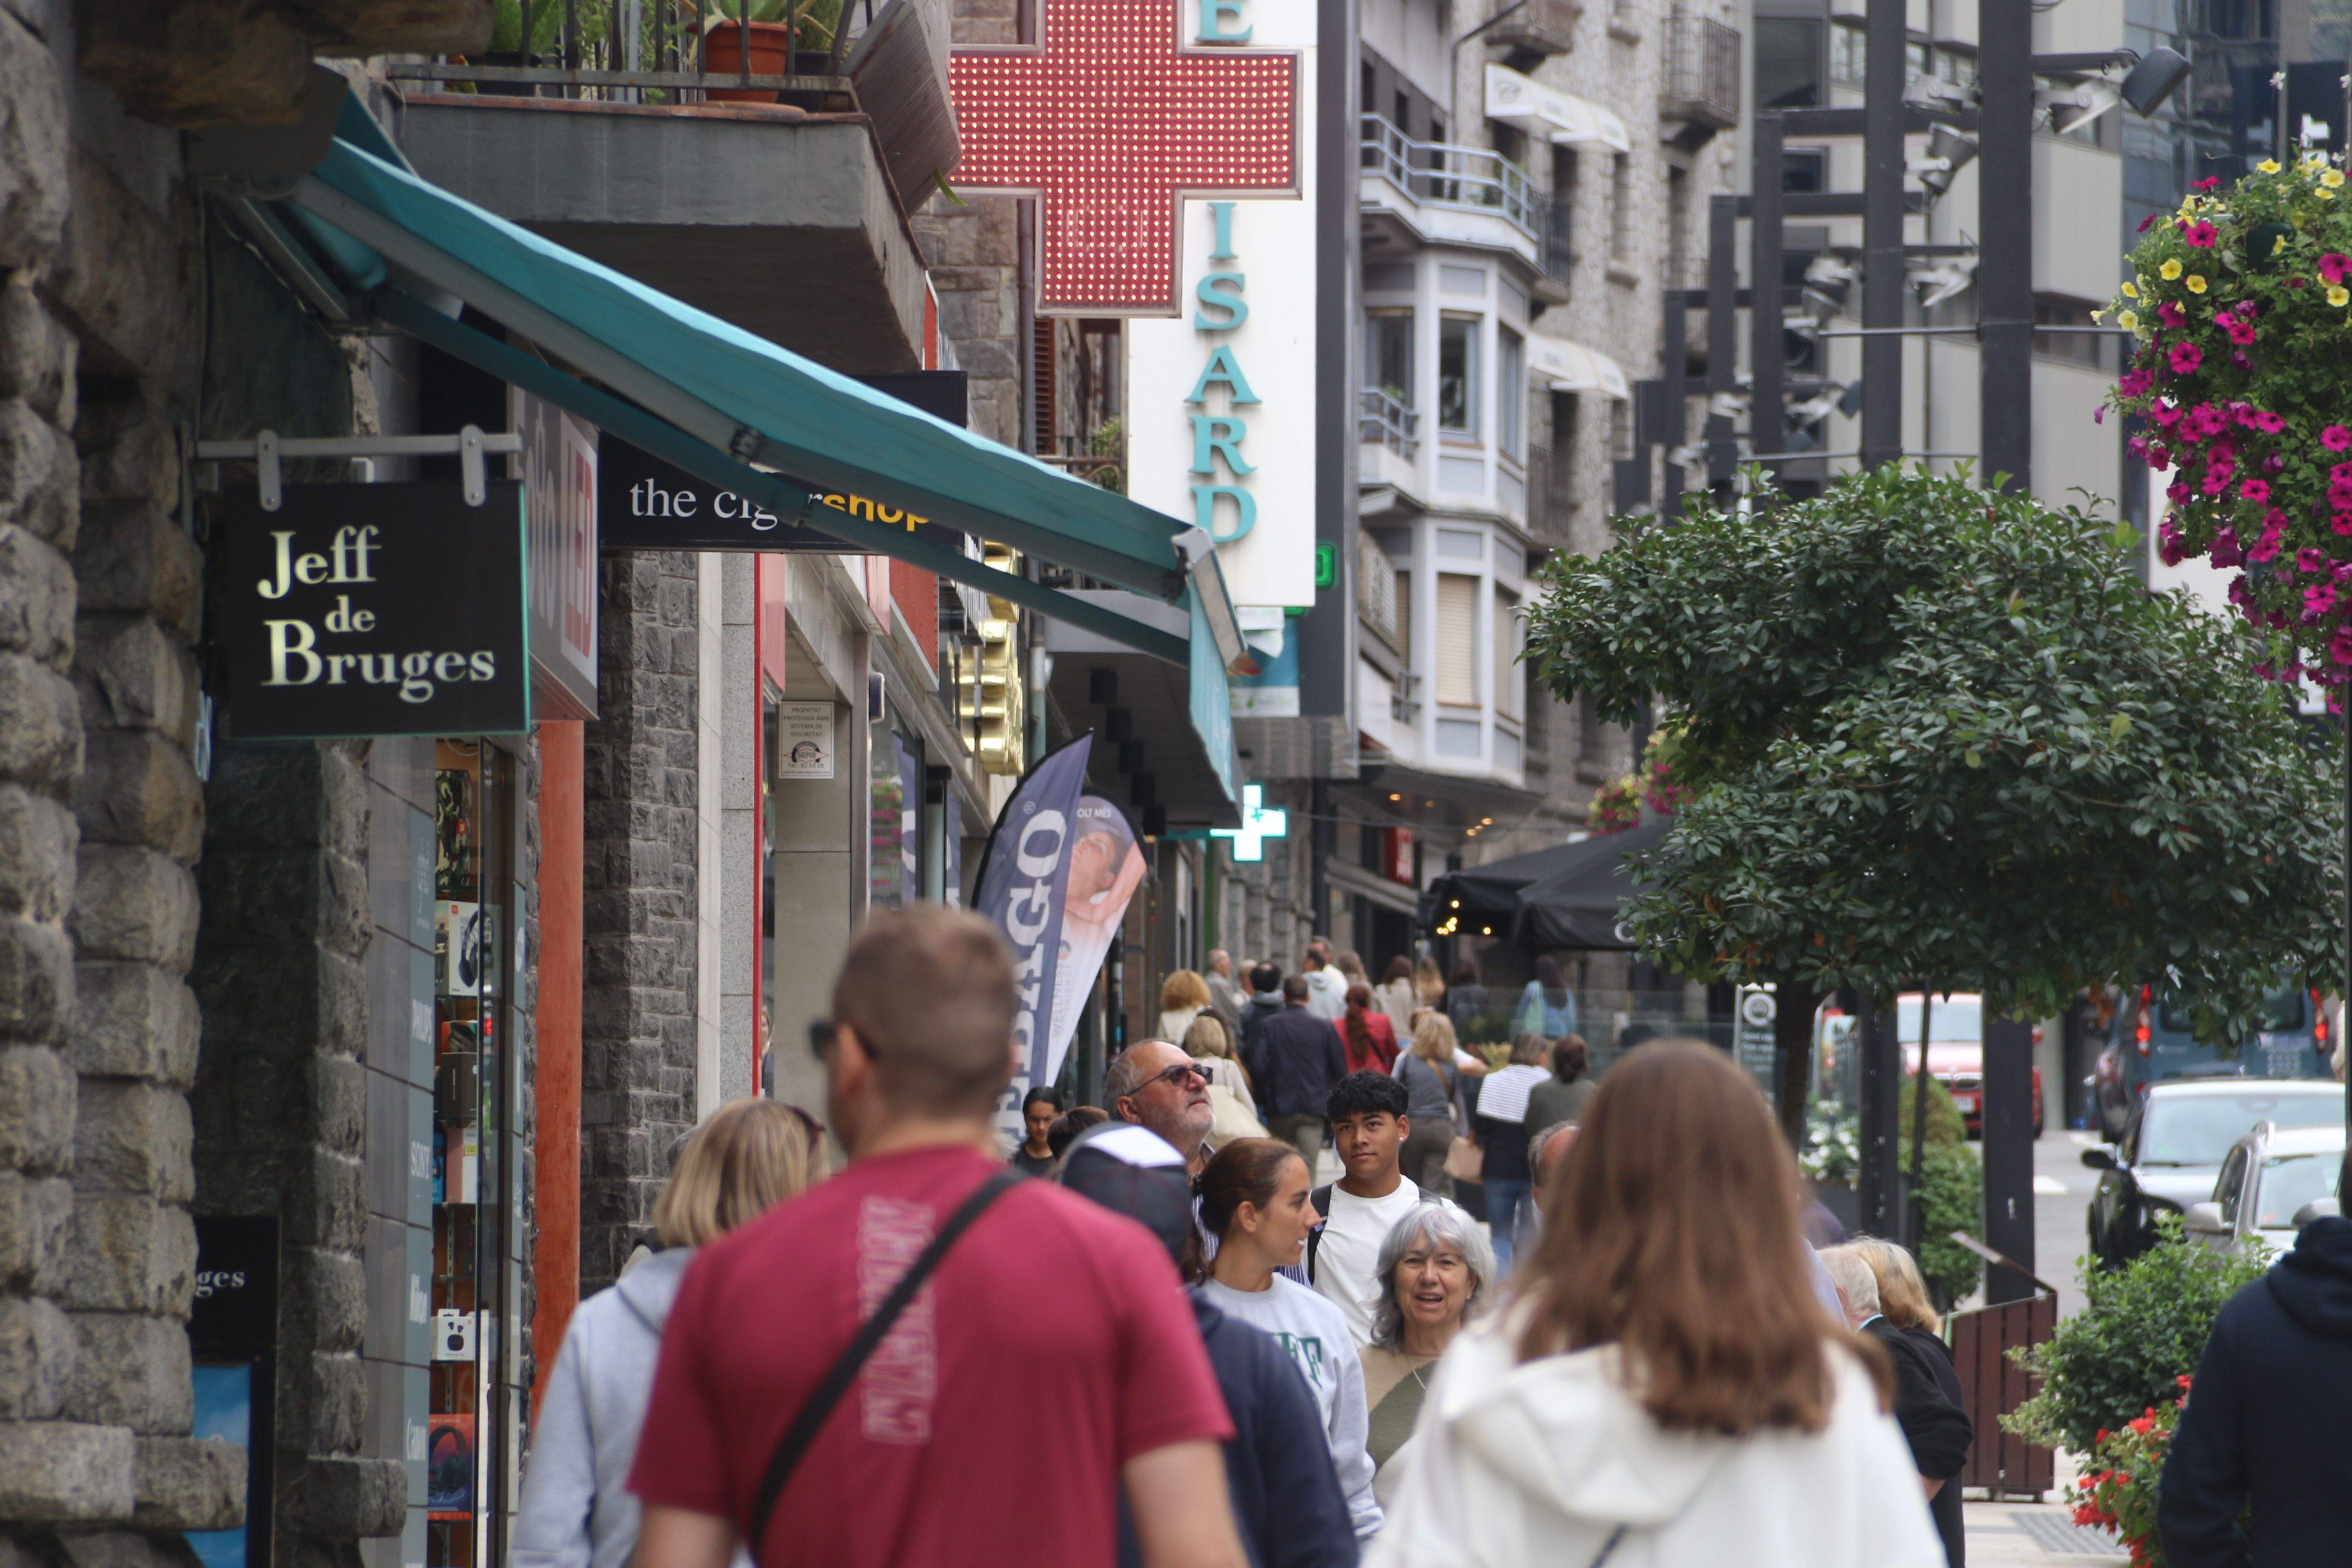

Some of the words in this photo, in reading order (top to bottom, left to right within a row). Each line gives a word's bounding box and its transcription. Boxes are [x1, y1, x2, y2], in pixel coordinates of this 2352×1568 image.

[1184, 202, 1262, 543] ISARD
[629, 478, 697, 518] the
[257, 524, 382, 599] Jeff
[325, 595, 375, 632] de
[261, 619, 495, 703] Bruges
[410, 1140, 430, 1179] SONY
